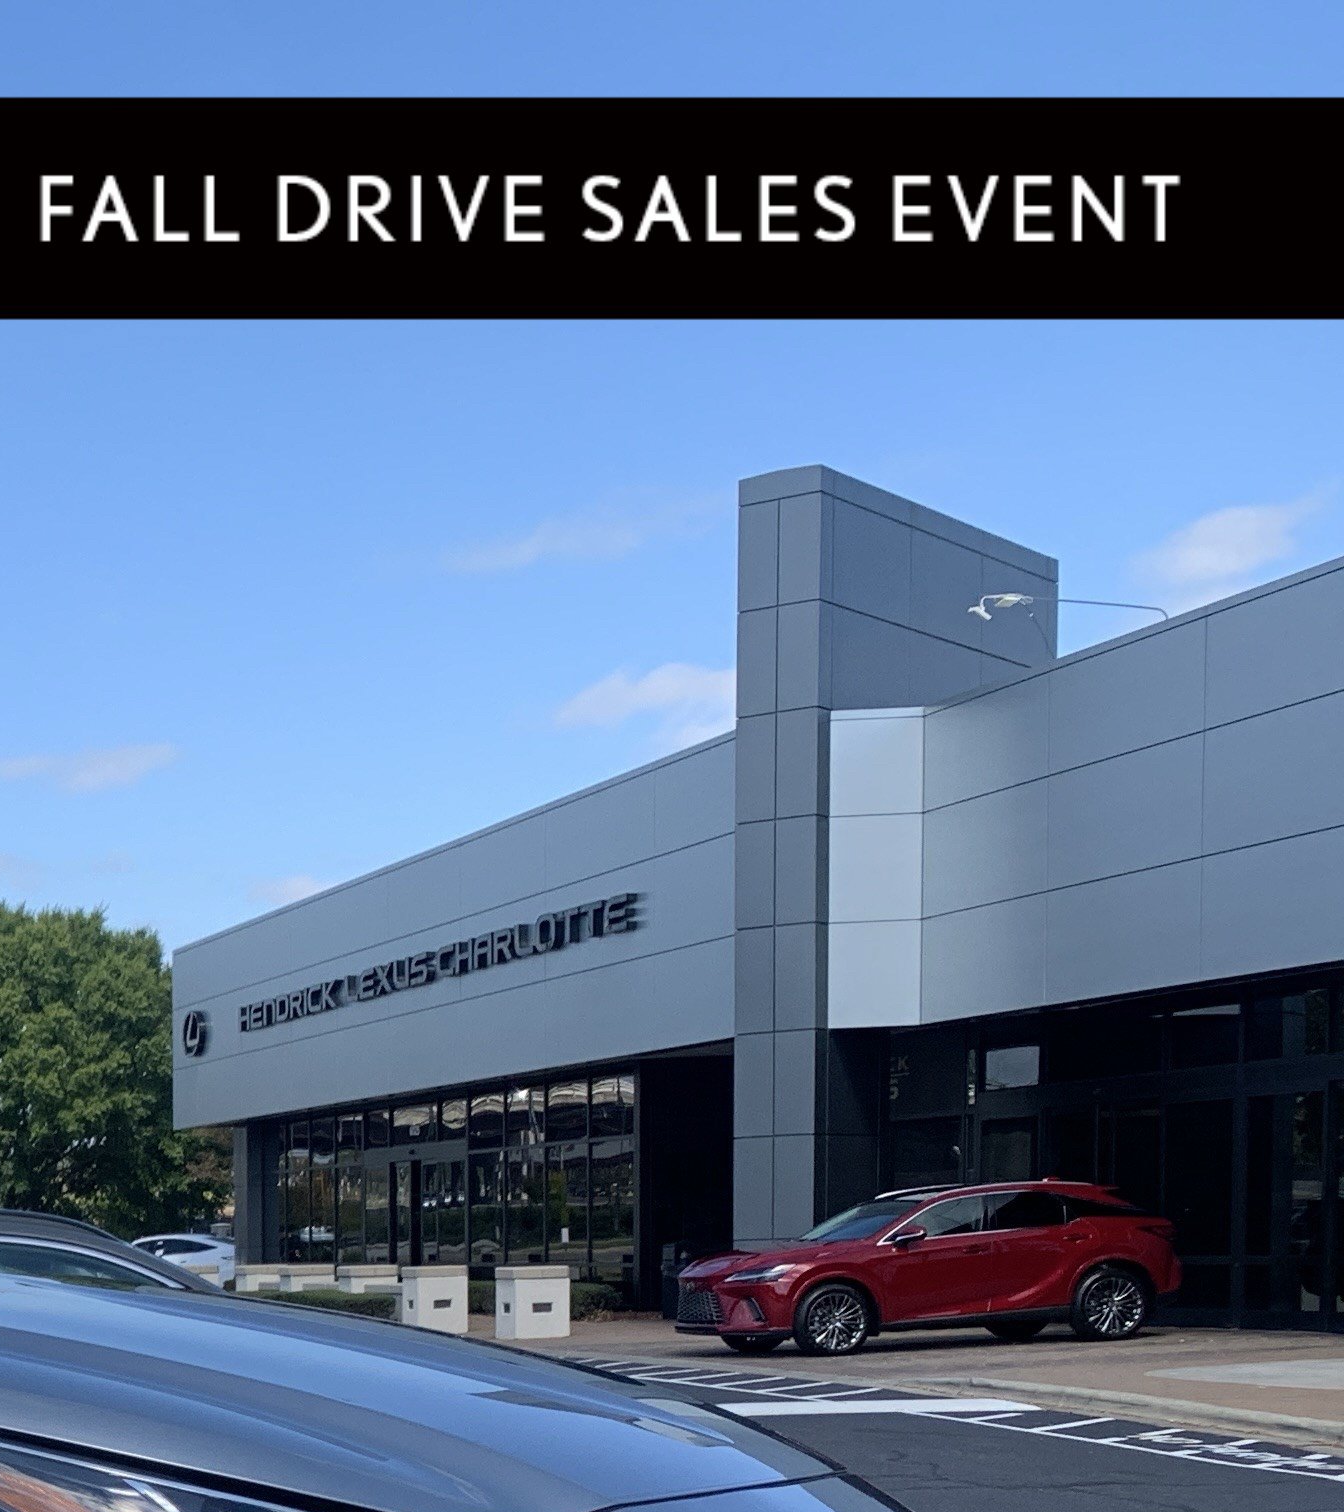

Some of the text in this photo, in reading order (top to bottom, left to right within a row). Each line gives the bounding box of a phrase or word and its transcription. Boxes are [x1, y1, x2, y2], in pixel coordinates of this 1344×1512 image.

[238, 892, 638, 1033] HENDRICK LEXUS CHARLOTTE
